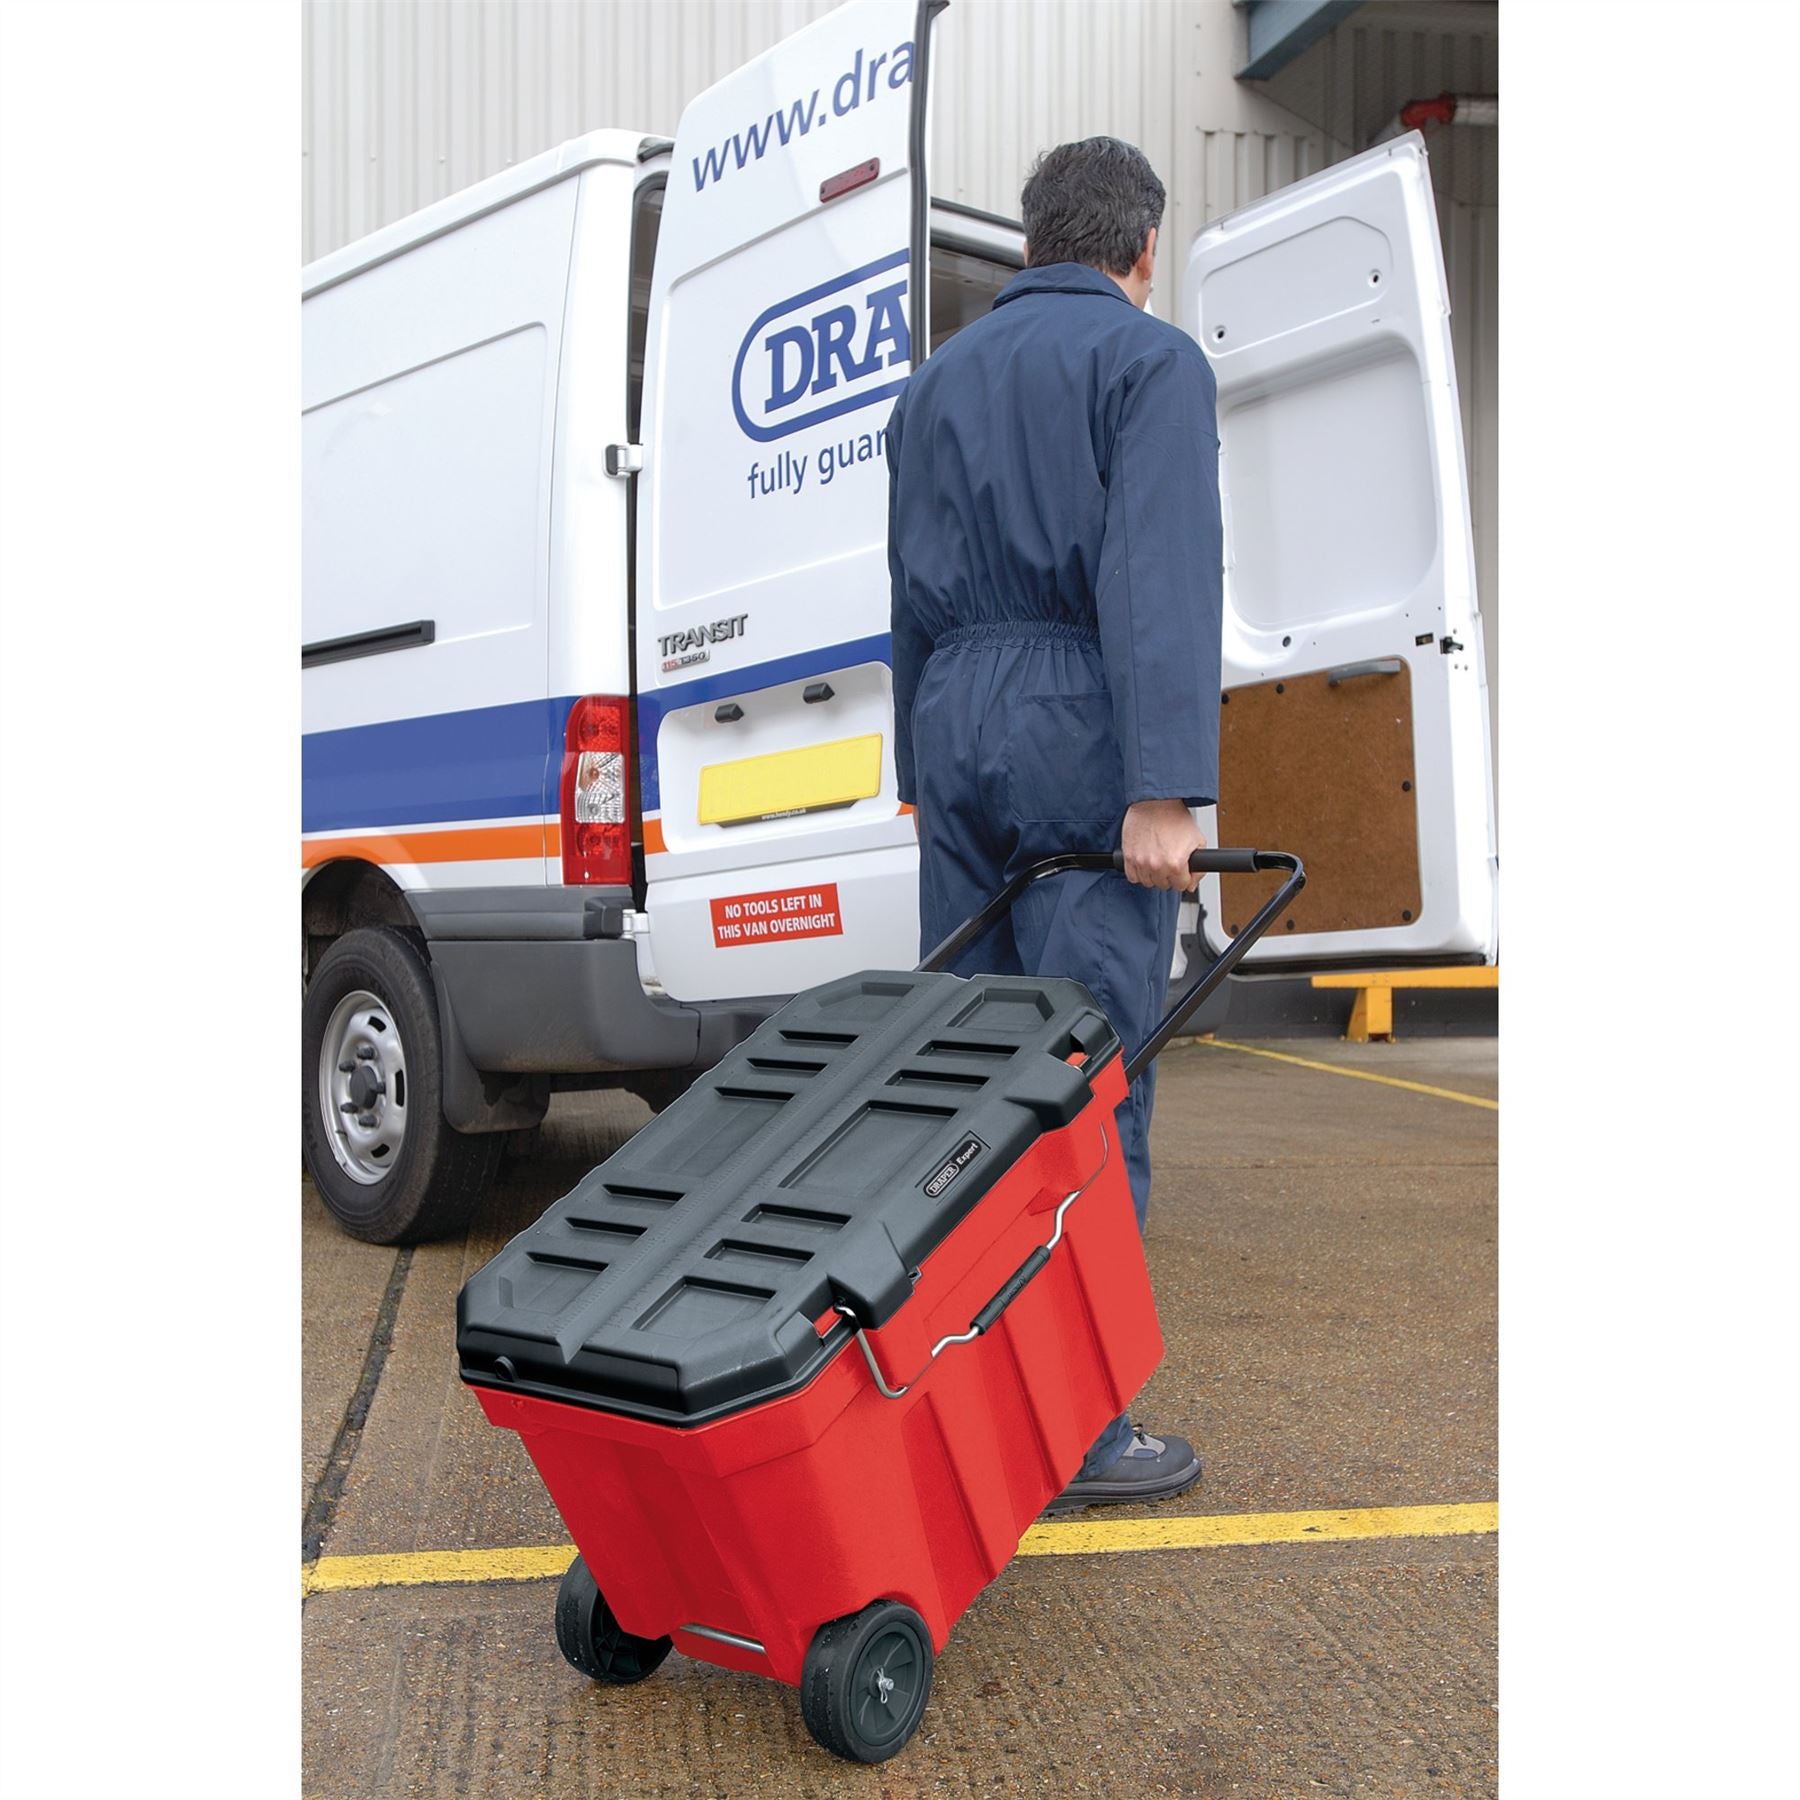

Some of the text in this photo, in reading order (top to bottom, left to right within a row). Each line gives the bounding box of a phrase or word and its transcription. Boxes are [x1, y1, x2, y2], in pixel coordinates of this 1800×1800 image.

[764, 279, 910, 414] DRA
[747, 450, 808, 499] fully
[658, 613, 749, 657] TRANSIT
[717, 912, 835, 940] THIS VAN OVERNIGHT
[725, 893, 823, 919] NO TOOLS LEFT IN
[929, 1142, 979, 1193] DRAPER Expert
